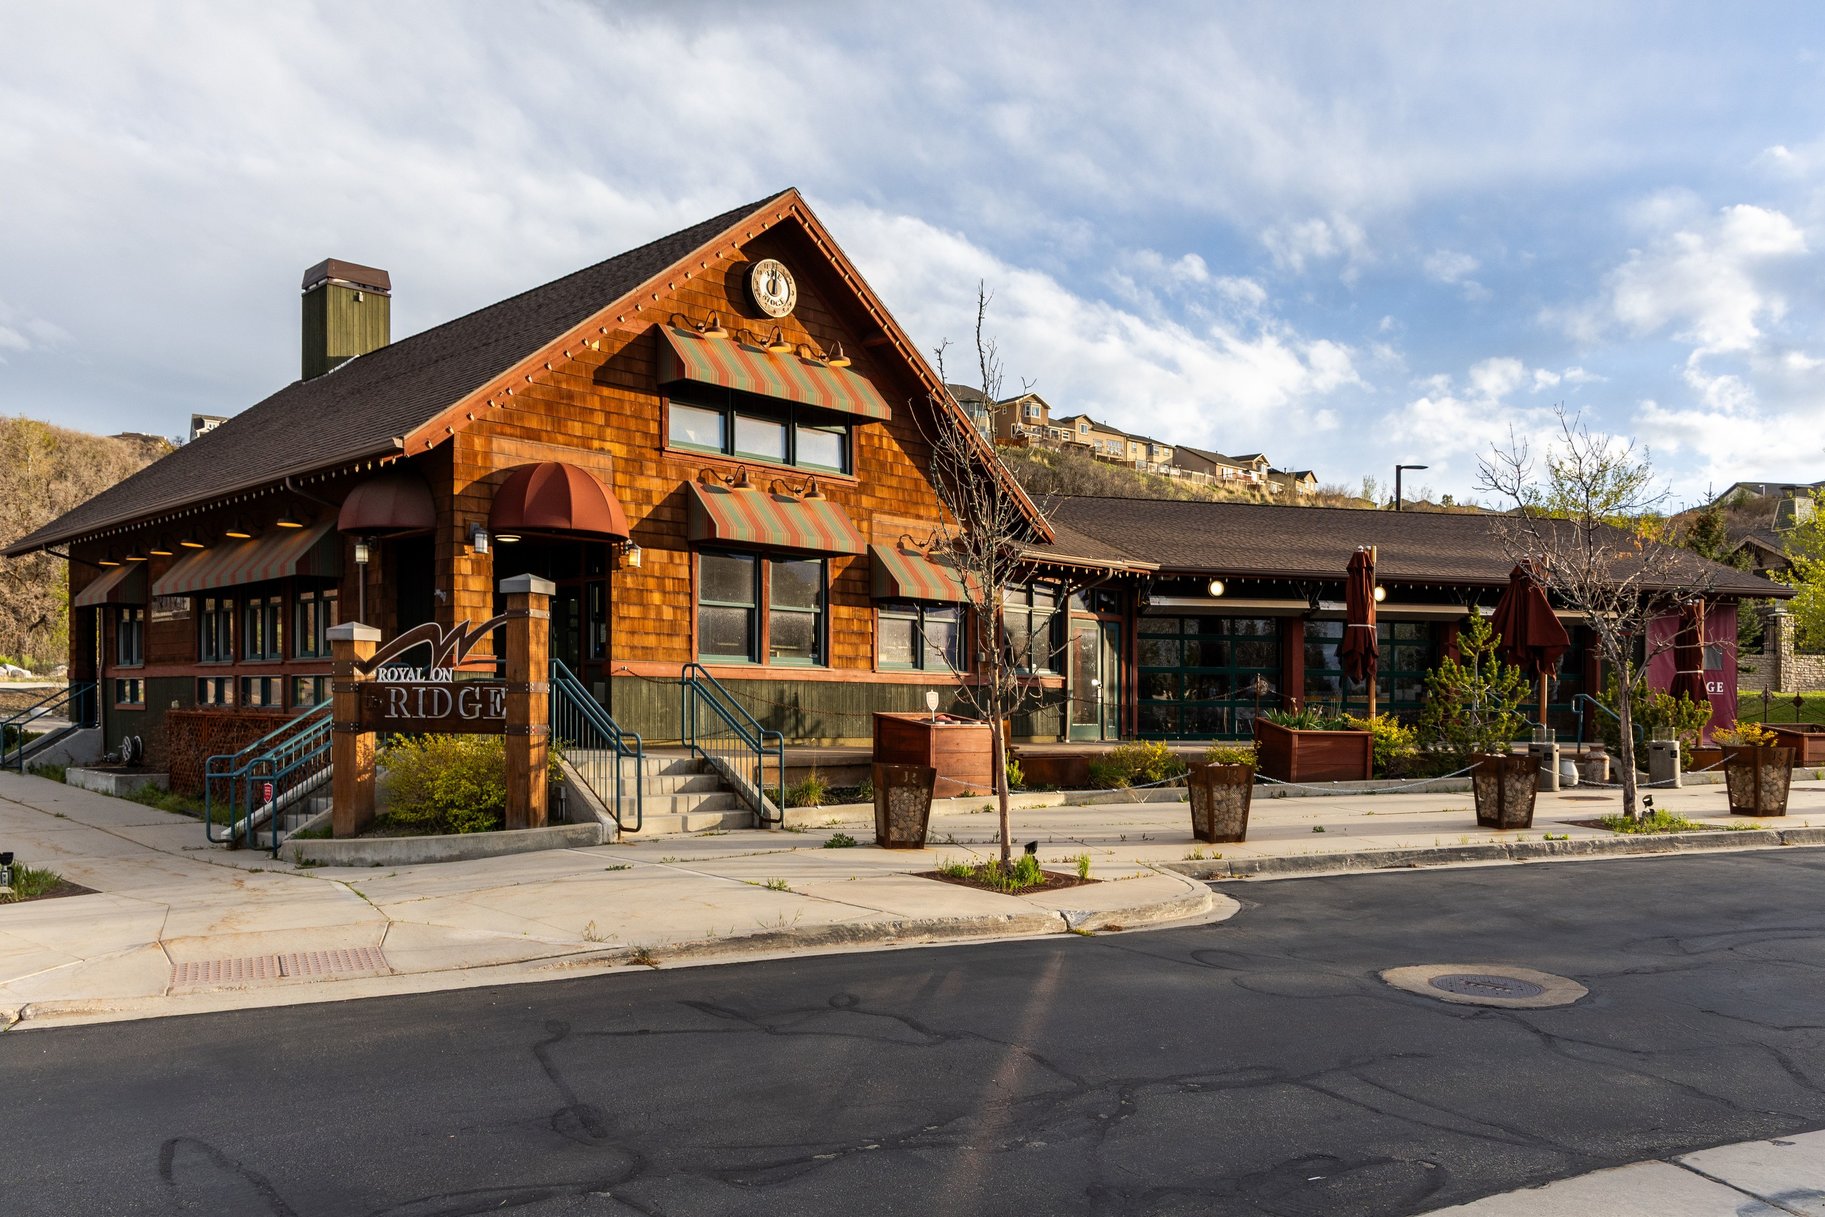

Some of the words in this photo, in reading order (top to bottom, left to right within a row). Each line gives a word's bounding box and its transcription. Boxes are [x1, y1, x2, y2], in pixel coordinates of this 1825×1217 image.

[378, 667, 426, 682] ROYAL
[431, 667, 453, 682] ON
[384, 686, 507, 719] RIDGE
